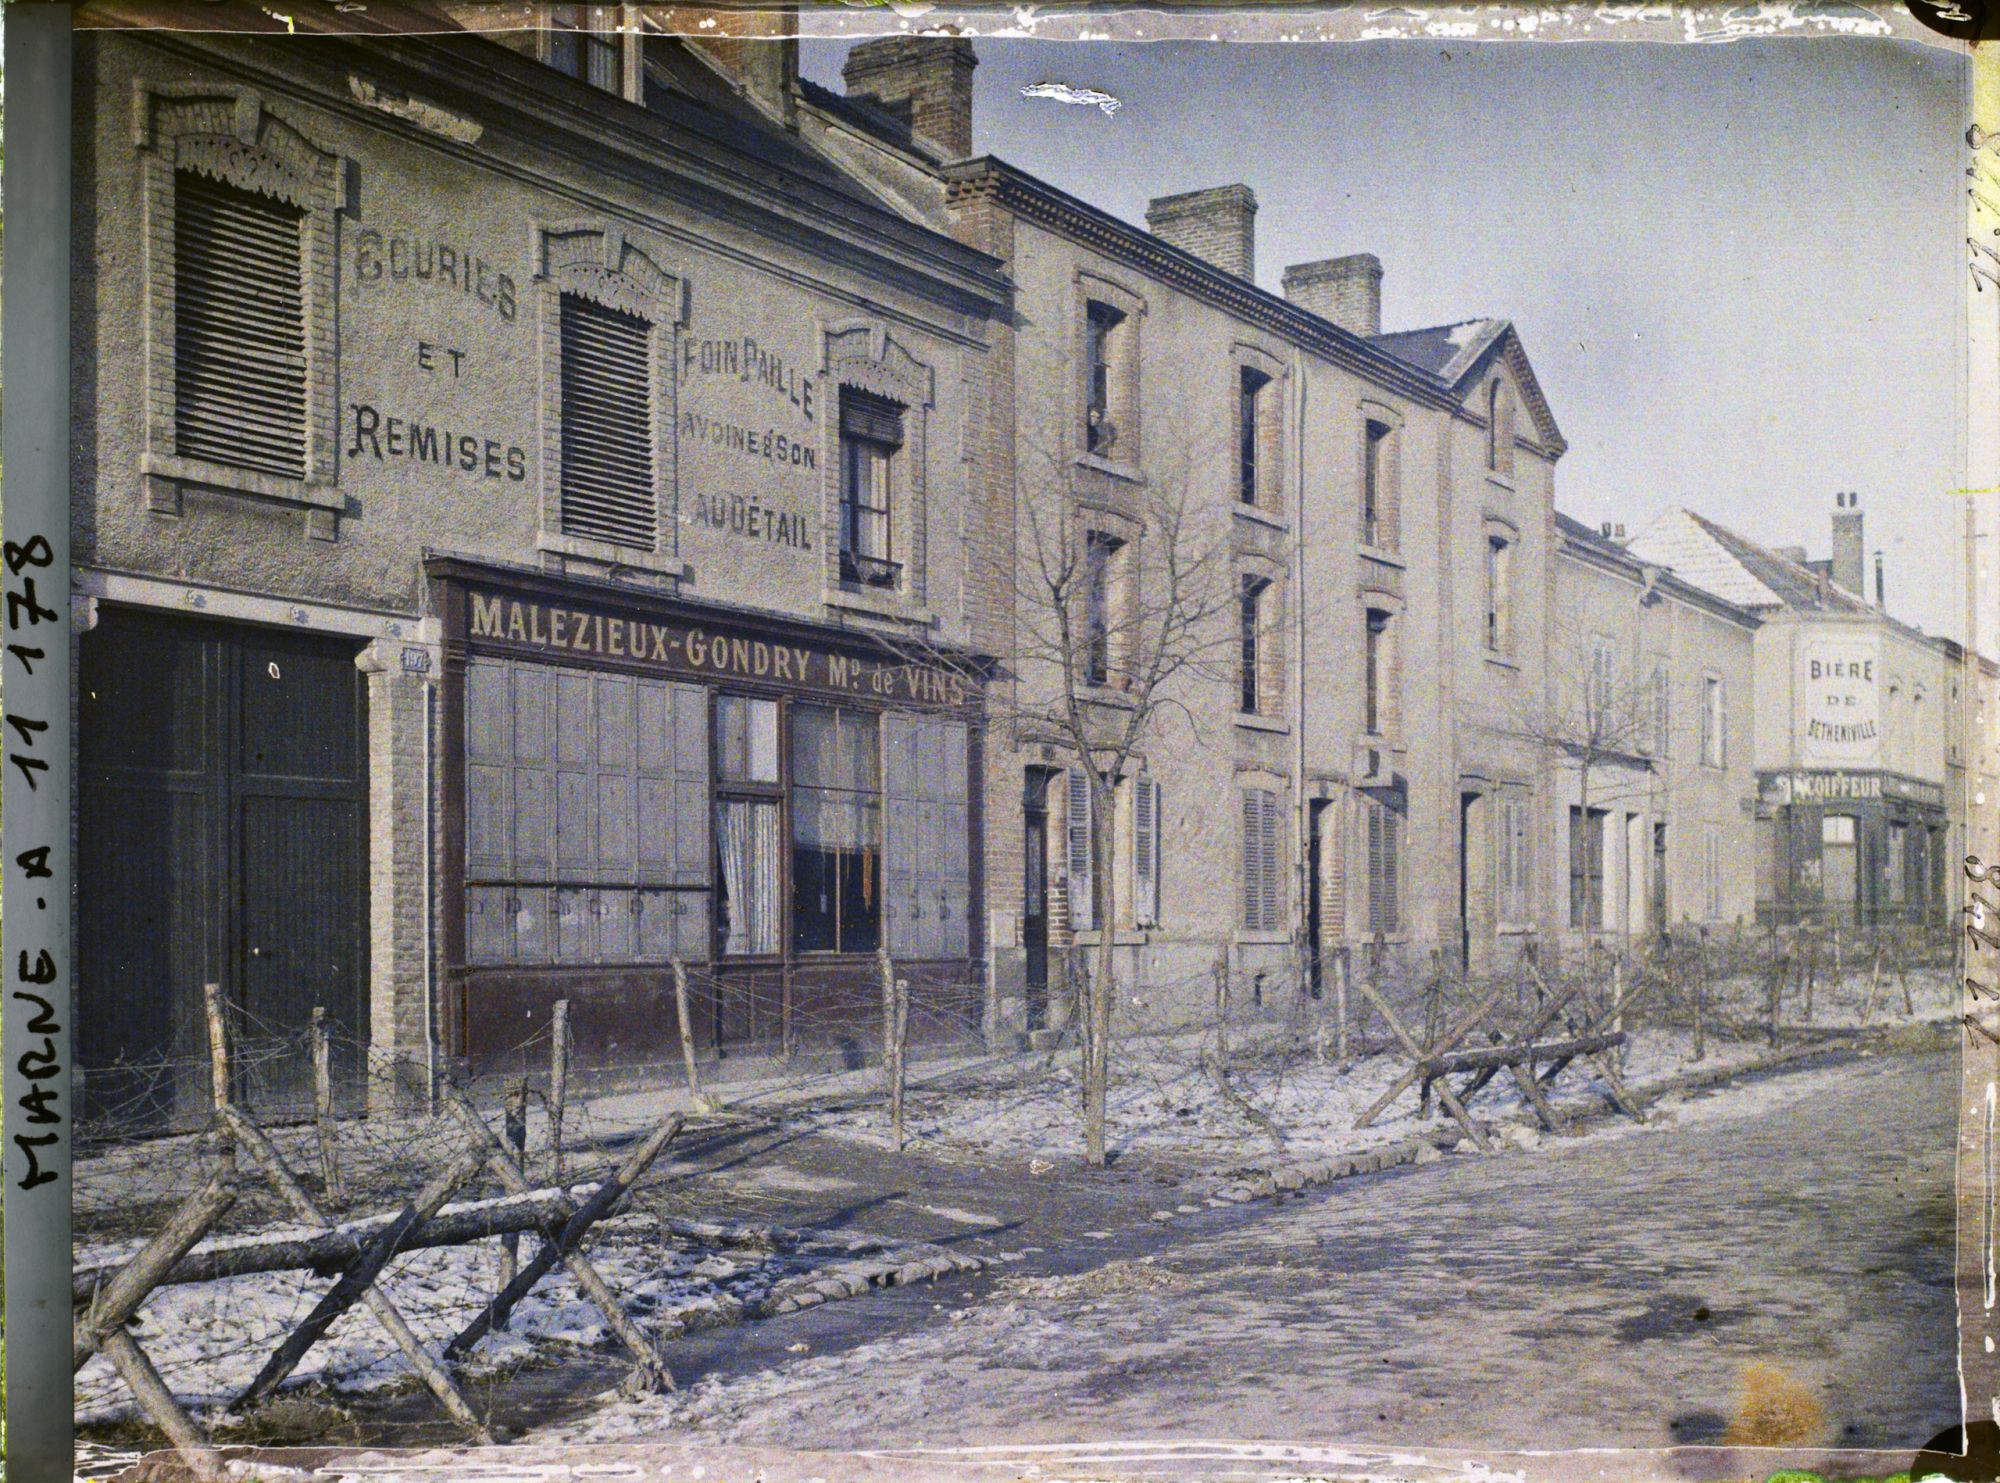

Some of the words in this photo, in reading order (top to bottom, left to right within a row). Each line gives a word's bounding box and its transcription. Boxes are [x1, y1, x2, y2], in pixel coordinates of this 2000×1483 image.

[418, 341, 465, 377] ET
[681, 338, 738, 384] FOIN
[741, 336, 813, 422] PAILLE
[348, 403, 526, 482] REMISES
[3, 535, 58, 675] 178
[470, 592, 810, 681] MALEZIEUX-GONDRY
[872, 663, 893, 694] de
[904, 665, 963, 703] VINS
[1827, 695, 1856, 706] DE
[1806, 776, 1881, 798] COIFFEUR
[14, 950, 61, 1189] MARNE
